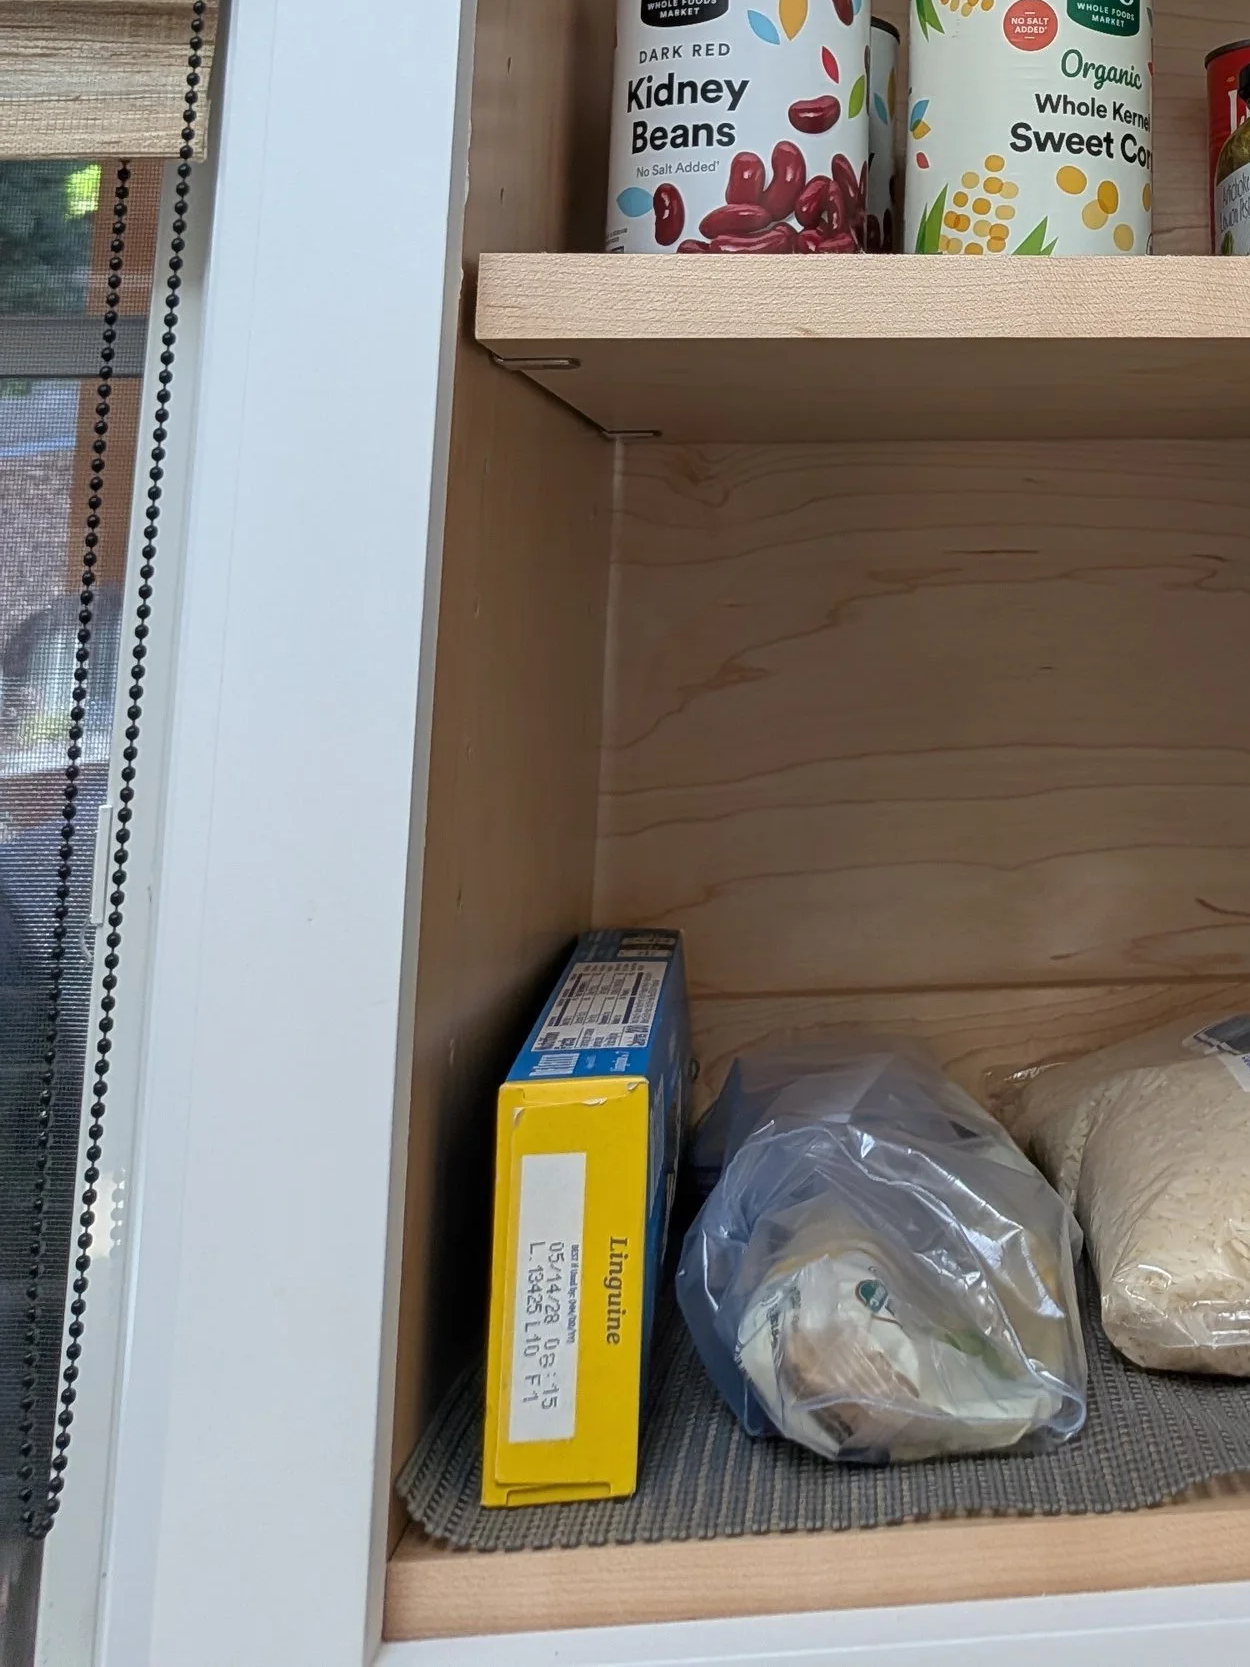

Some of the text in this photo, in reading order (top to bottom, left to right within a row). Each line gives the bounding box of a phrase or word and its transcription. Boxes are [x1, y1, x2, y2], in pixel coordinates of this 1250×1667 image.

[647, 0, 679, 11] WHOLE
[660, 7, 700, 19] MARKET
[1076, 2, 1135, 21] WHOLE FOODS
[1011, 17, 1049, 25] NO SALT
[1091, 14, 1126, 28] MARKET
[639, 42, 731, 64] DARK RED
[1061, 48, 1143, 90] Organic
[626, 72, 750, 113] Kidney
[1035, 93, 1108, 119] Whole
[632, 121, 736, 154] Beans
[1009, 122, 1115, 159] Sweet
[637, 166, 650, 178] No
[652, 163, 673, 176] Salt
[543, 1241, 565, 1324] 05/14/28
[604, 1236, 629, 1345] Linguine
